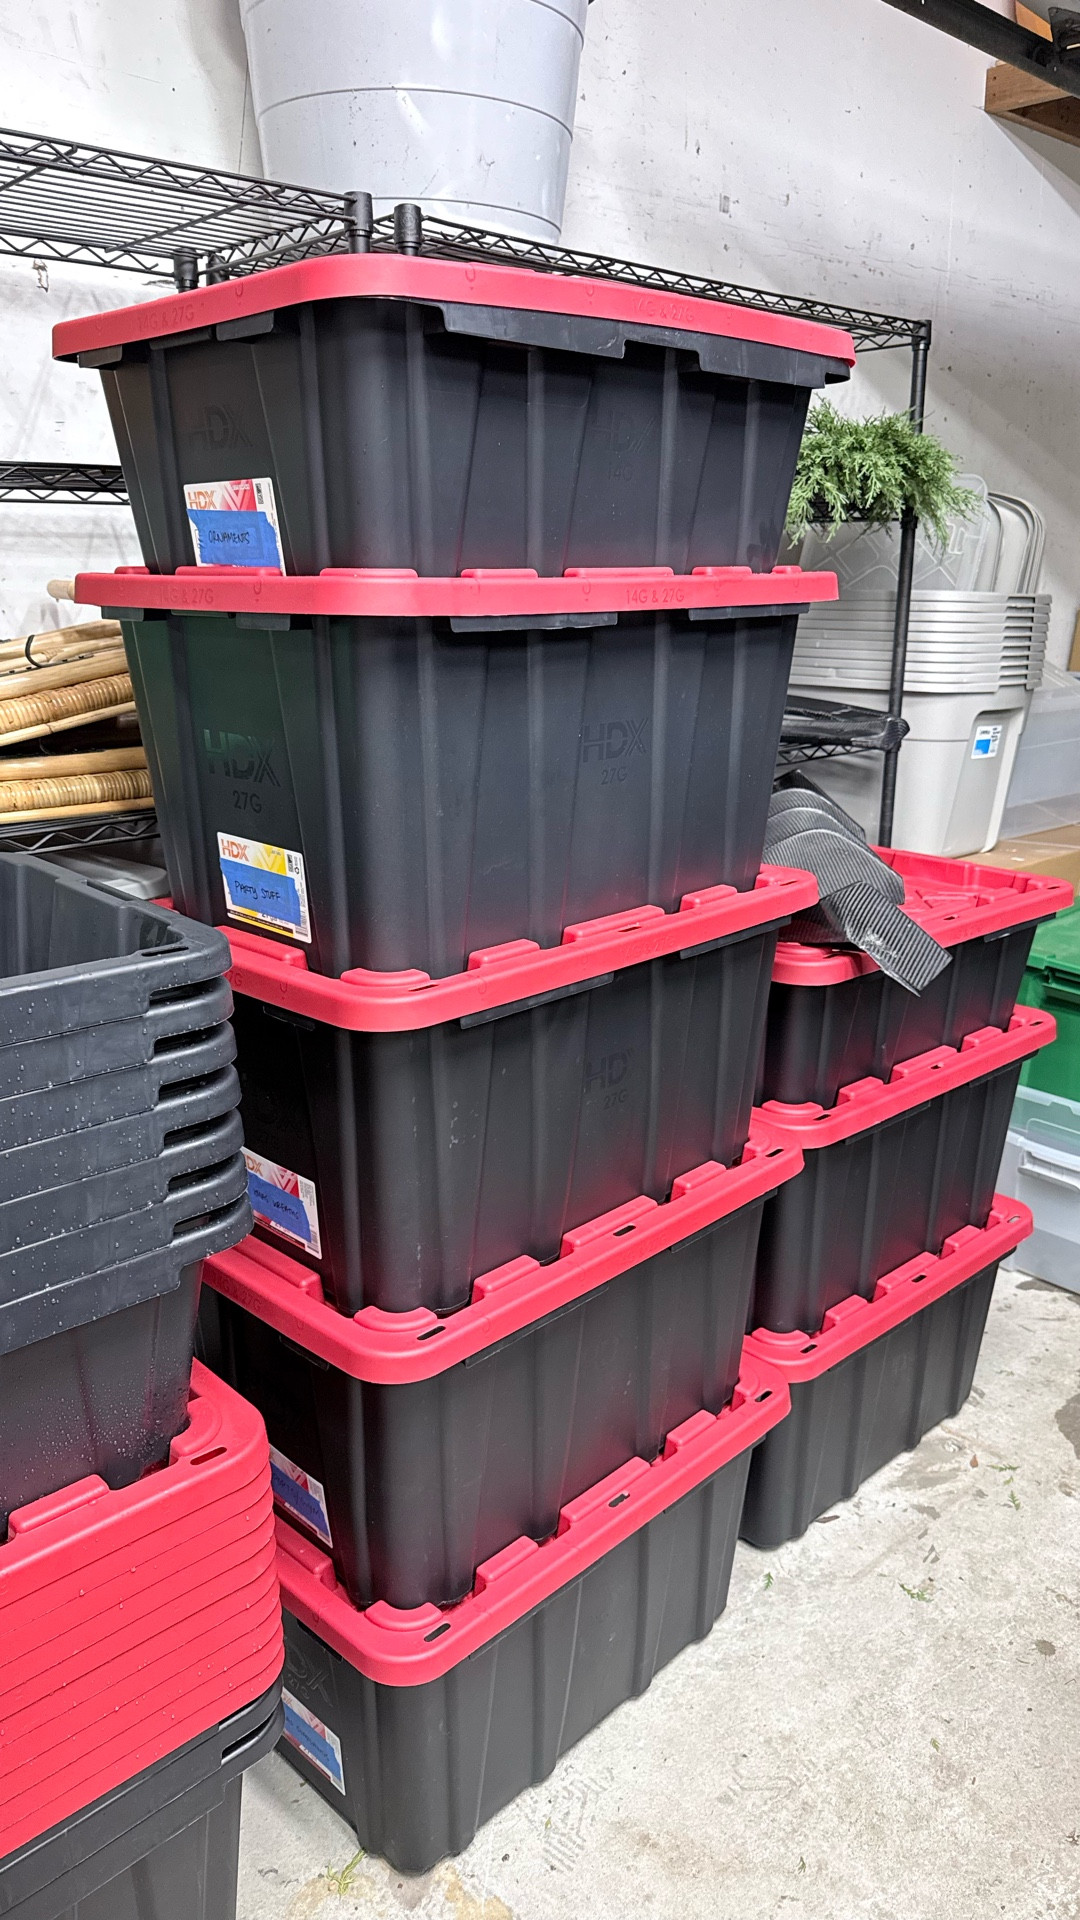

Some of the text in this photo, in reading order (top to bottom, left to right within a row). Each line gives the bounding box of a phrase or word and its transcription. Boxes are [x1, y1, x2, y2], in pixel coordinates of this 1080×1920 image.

[171, 303, 195, 326] 27G
[186, 490, 217, 510] HDX
[191, 587, 214, 604] 27G
[625, 587, 685, 604] 14G & 27G
[582, 717, 649, 764] HDX
[203, 728, 281, 787] HDX
[600, 765, 629, 786] 27G
[232, 790, 263, 814] 27G
[220, 838, 249, 862] HDX
[234, 880, 281, 900] PARTY STUFF
